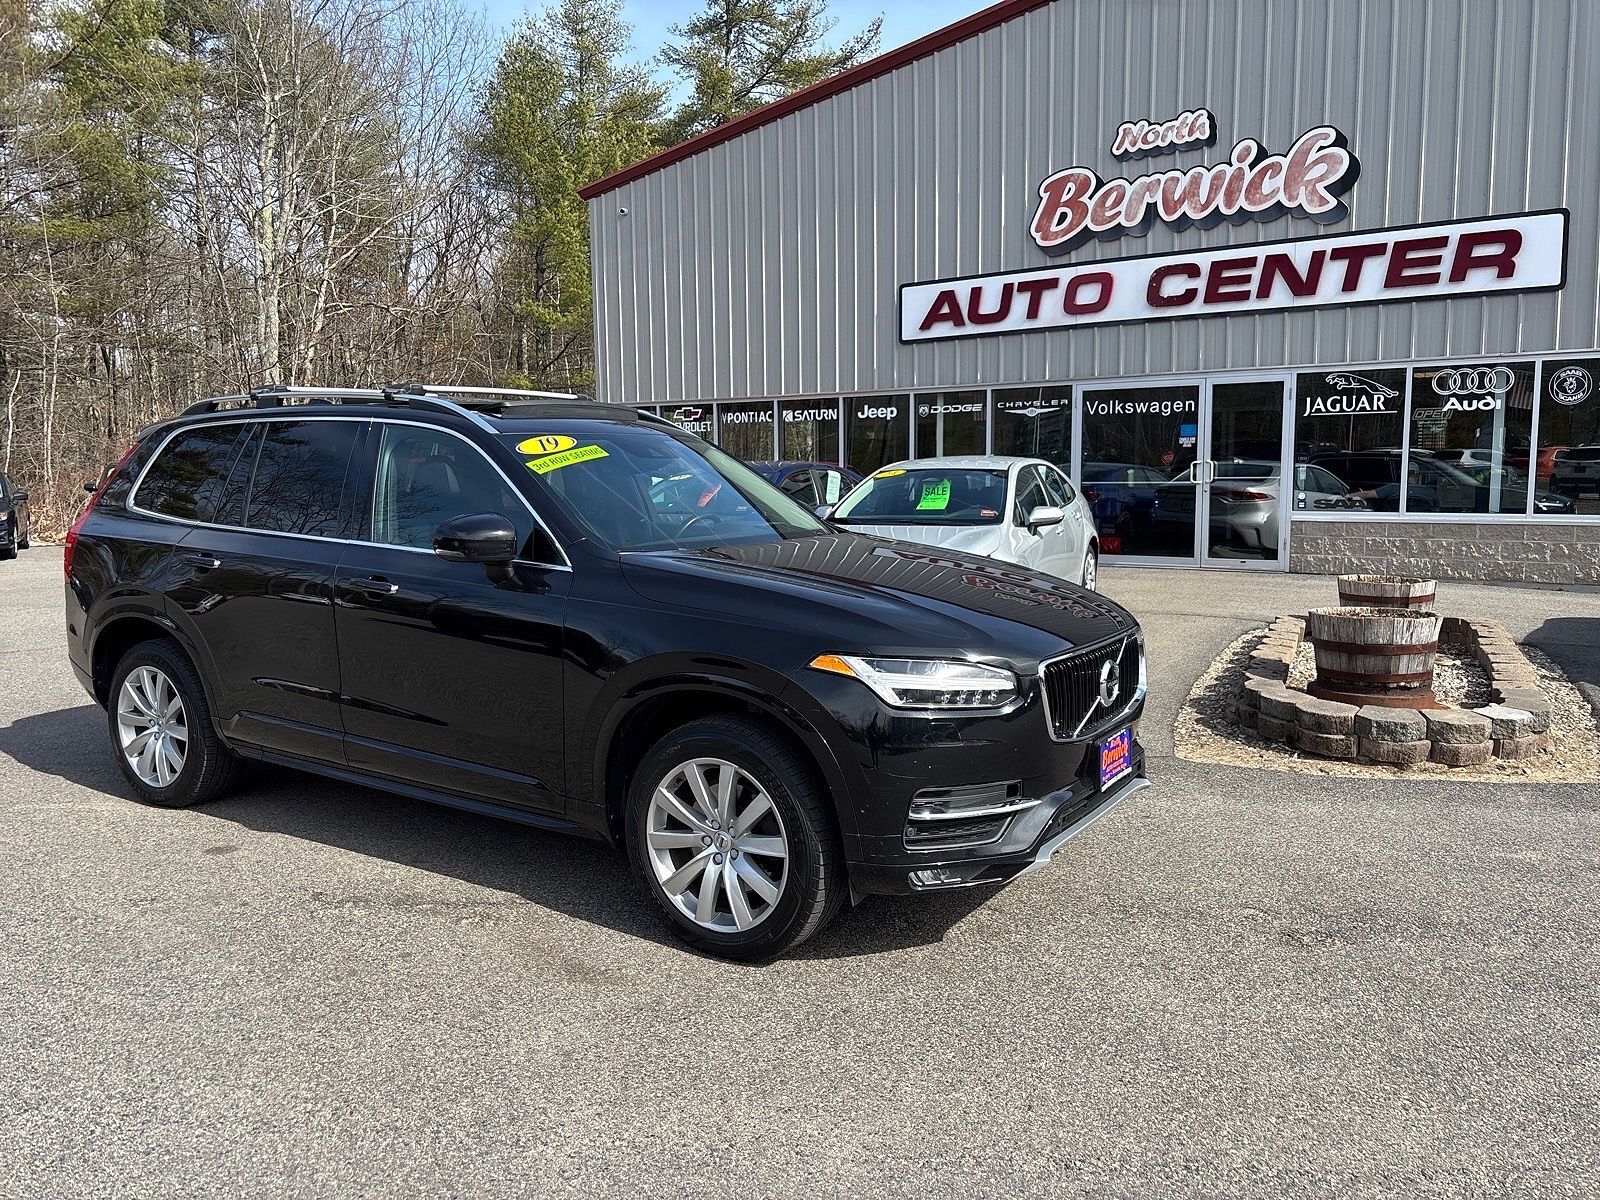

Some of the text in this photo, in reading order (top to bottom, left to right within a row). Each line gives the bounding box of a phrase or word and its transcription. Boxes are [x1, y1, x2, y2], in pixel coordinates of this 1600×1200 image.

[1114, 110, 1211, 154] North
[1032, 127, 1347, 245] Berwick
[918, 228, 1523, 331] AUTO CENTER
[1560, 369, 1583, 378] SAAB
[930, 403, 983, 414] DODGE
[997, 398, 1069, 408] CHRYSLER
[1086, 399, 1195, 417] Volkswagen
[1303, 394, 1386, 417] JAGUAR
[1441, 395, 1502, 412] Audi
[727, 410, 773, 424] PONTIAC
[794, 408, 838, 422] SATURN
[857, 404, 898, 420] Jeep
[675, 421, 712, 432] VROLET
[538, 436, 559, 452] 19
[532, 447, 604, 471] 3rd ROW SEATING
[924, 486, 948, 497] SALE
